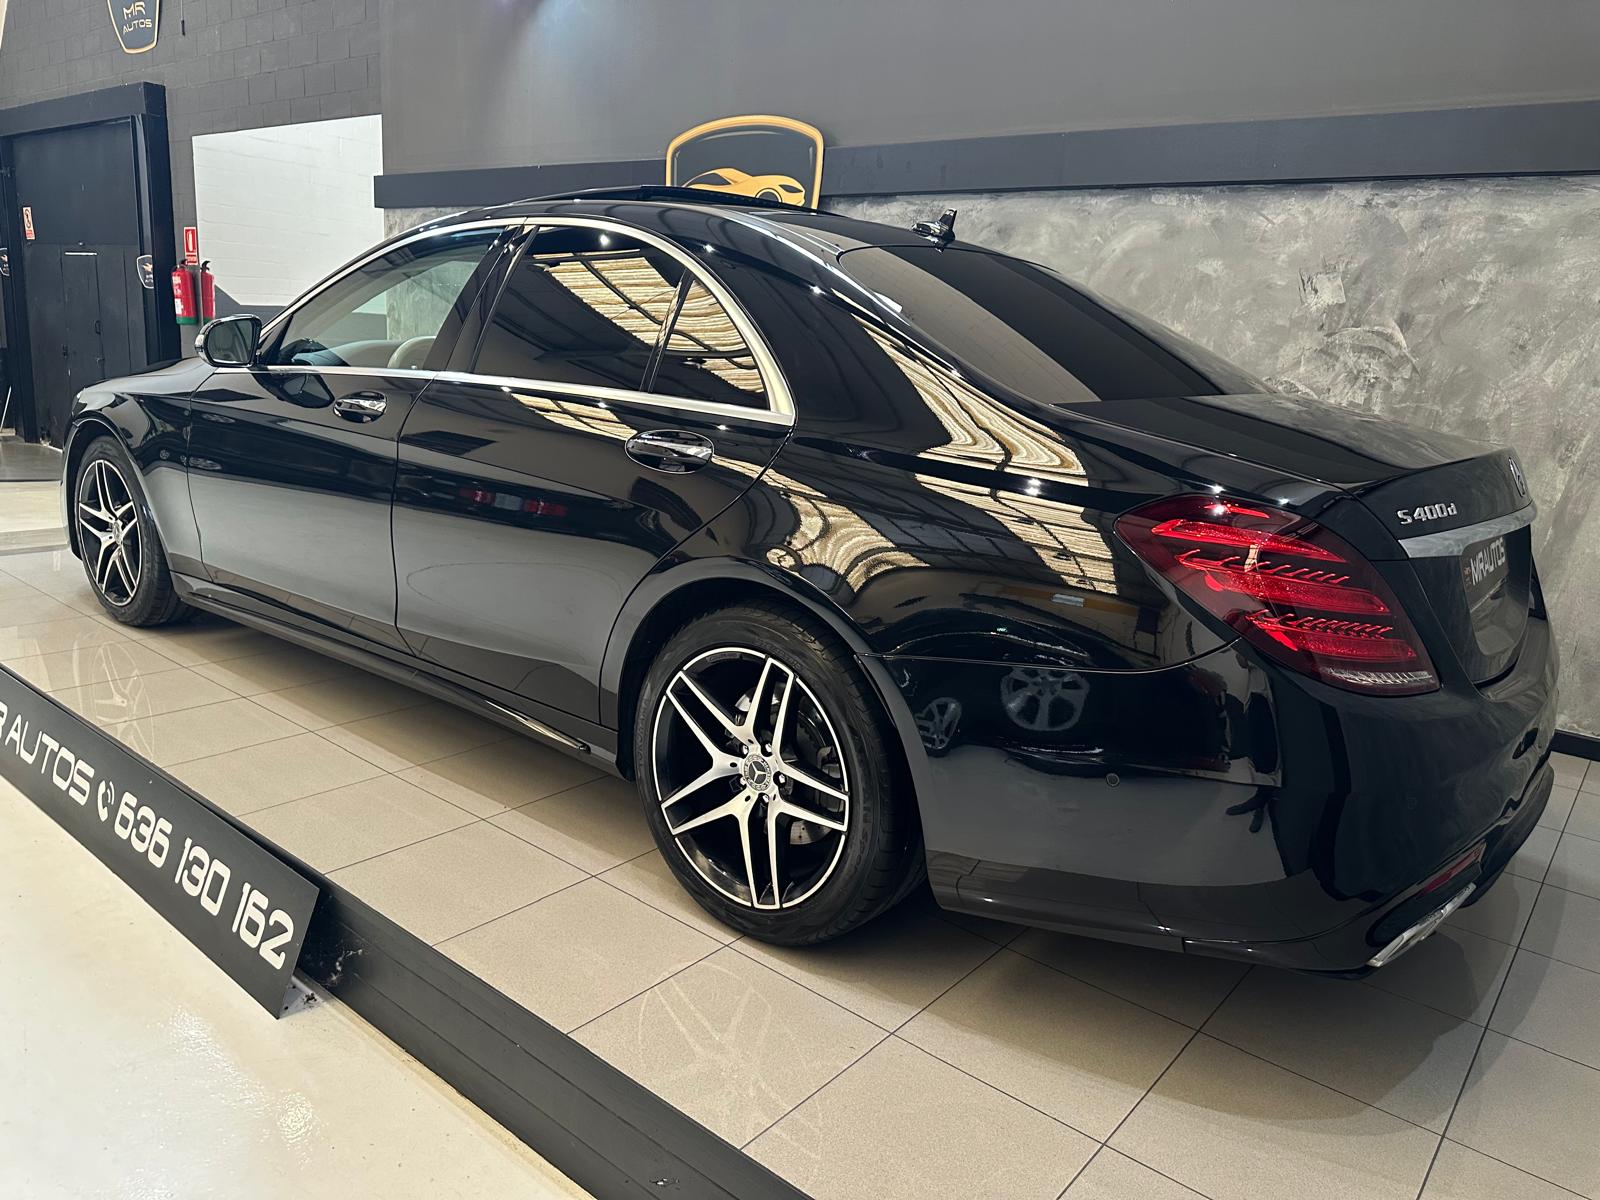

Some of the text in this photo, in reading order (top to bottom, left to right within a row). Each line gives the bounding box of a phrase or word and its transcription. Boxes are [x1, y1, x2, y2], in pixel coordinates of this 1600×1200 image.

[123, 1, 146, 20] MR
[123, 18, 153, 35] AUTOS
[5, 714, 95, 806] AUTOS
[114, 791, 173, 868] 636
[174, 837, 231, 917] 130
[232, 882, 294, 970] 162
